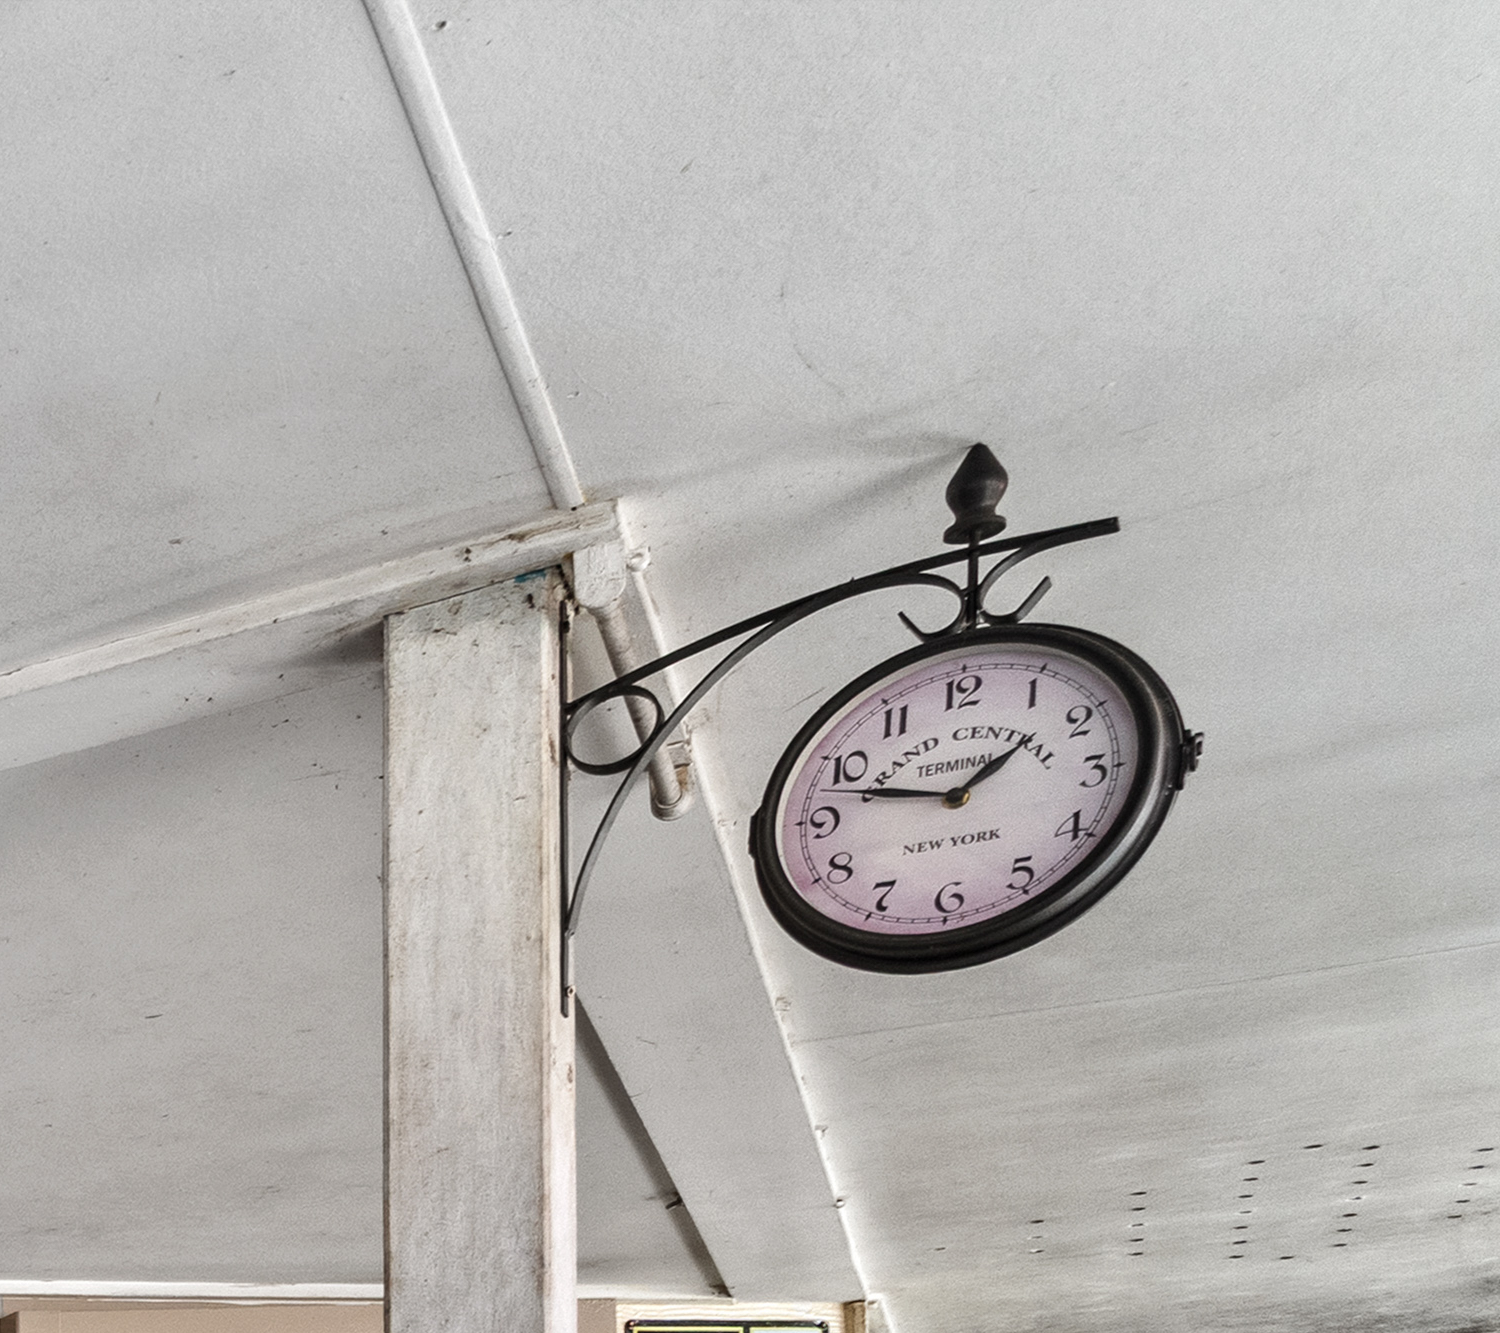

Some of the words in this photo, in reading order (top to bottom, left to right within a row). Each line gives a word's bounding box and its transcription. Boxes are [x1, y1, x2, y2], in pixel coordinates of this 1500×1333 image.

[944, 674, 982, 712] 12
[1028, 677, 1039, 710] 1
[882, 704, 909, 740] 11
[1065, 705, 1094, 740] 2
[830, 750, 869, 787] 10
[860, 736, 940, 804] GRAND
[950, 725, 1054, 771] CENTRAL
[915, 752, 995, 779] TERMINAL
[1079, 753, 1107, 788] 3
[808, 806, 841, 840] 9
[1053, 809, 1088, 843] 4
[901, 836, 946, 856] NEW
[949, 827, 1002, 850] YORK
[826, 851, 854, 885] 8
[1006, 855, 1035, 891] 5
[871, 879, 898, 913] 7
[934, 881, 965, 913] 6
